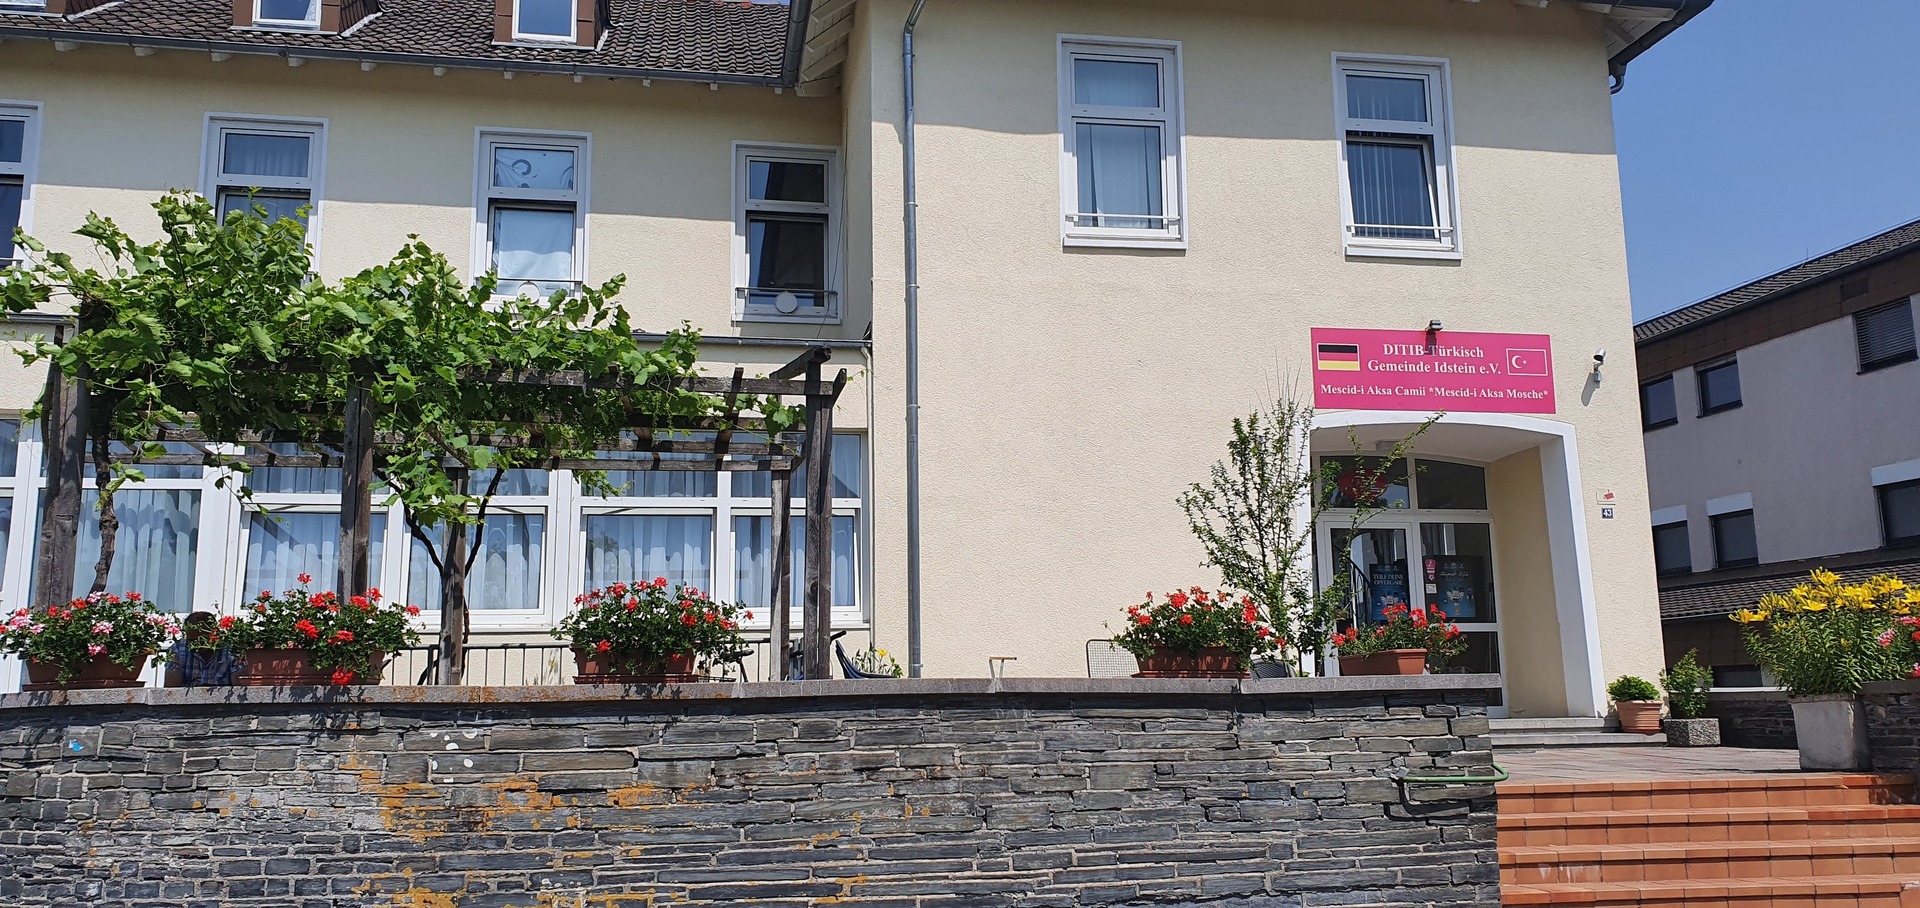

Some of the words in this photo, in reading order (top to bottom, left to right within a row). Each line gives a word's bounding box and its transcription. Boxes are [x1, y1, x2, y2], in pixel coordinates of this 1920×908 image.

[1383, 343, 1484, 358] DITIB-Türkisch
[1367, 359, 1431, 373] Gemeinde
[1433, 362, 1476, 374] Idstein
[1479, 363, 1501, 375] e.V.
[1321, 384, 1365, 395] Mescid-i
[1367, 385, 1392, 396] Aksa
[1395, 386, 1426, 396] Camii
[1479, 388, 1504, 398] Aksa
